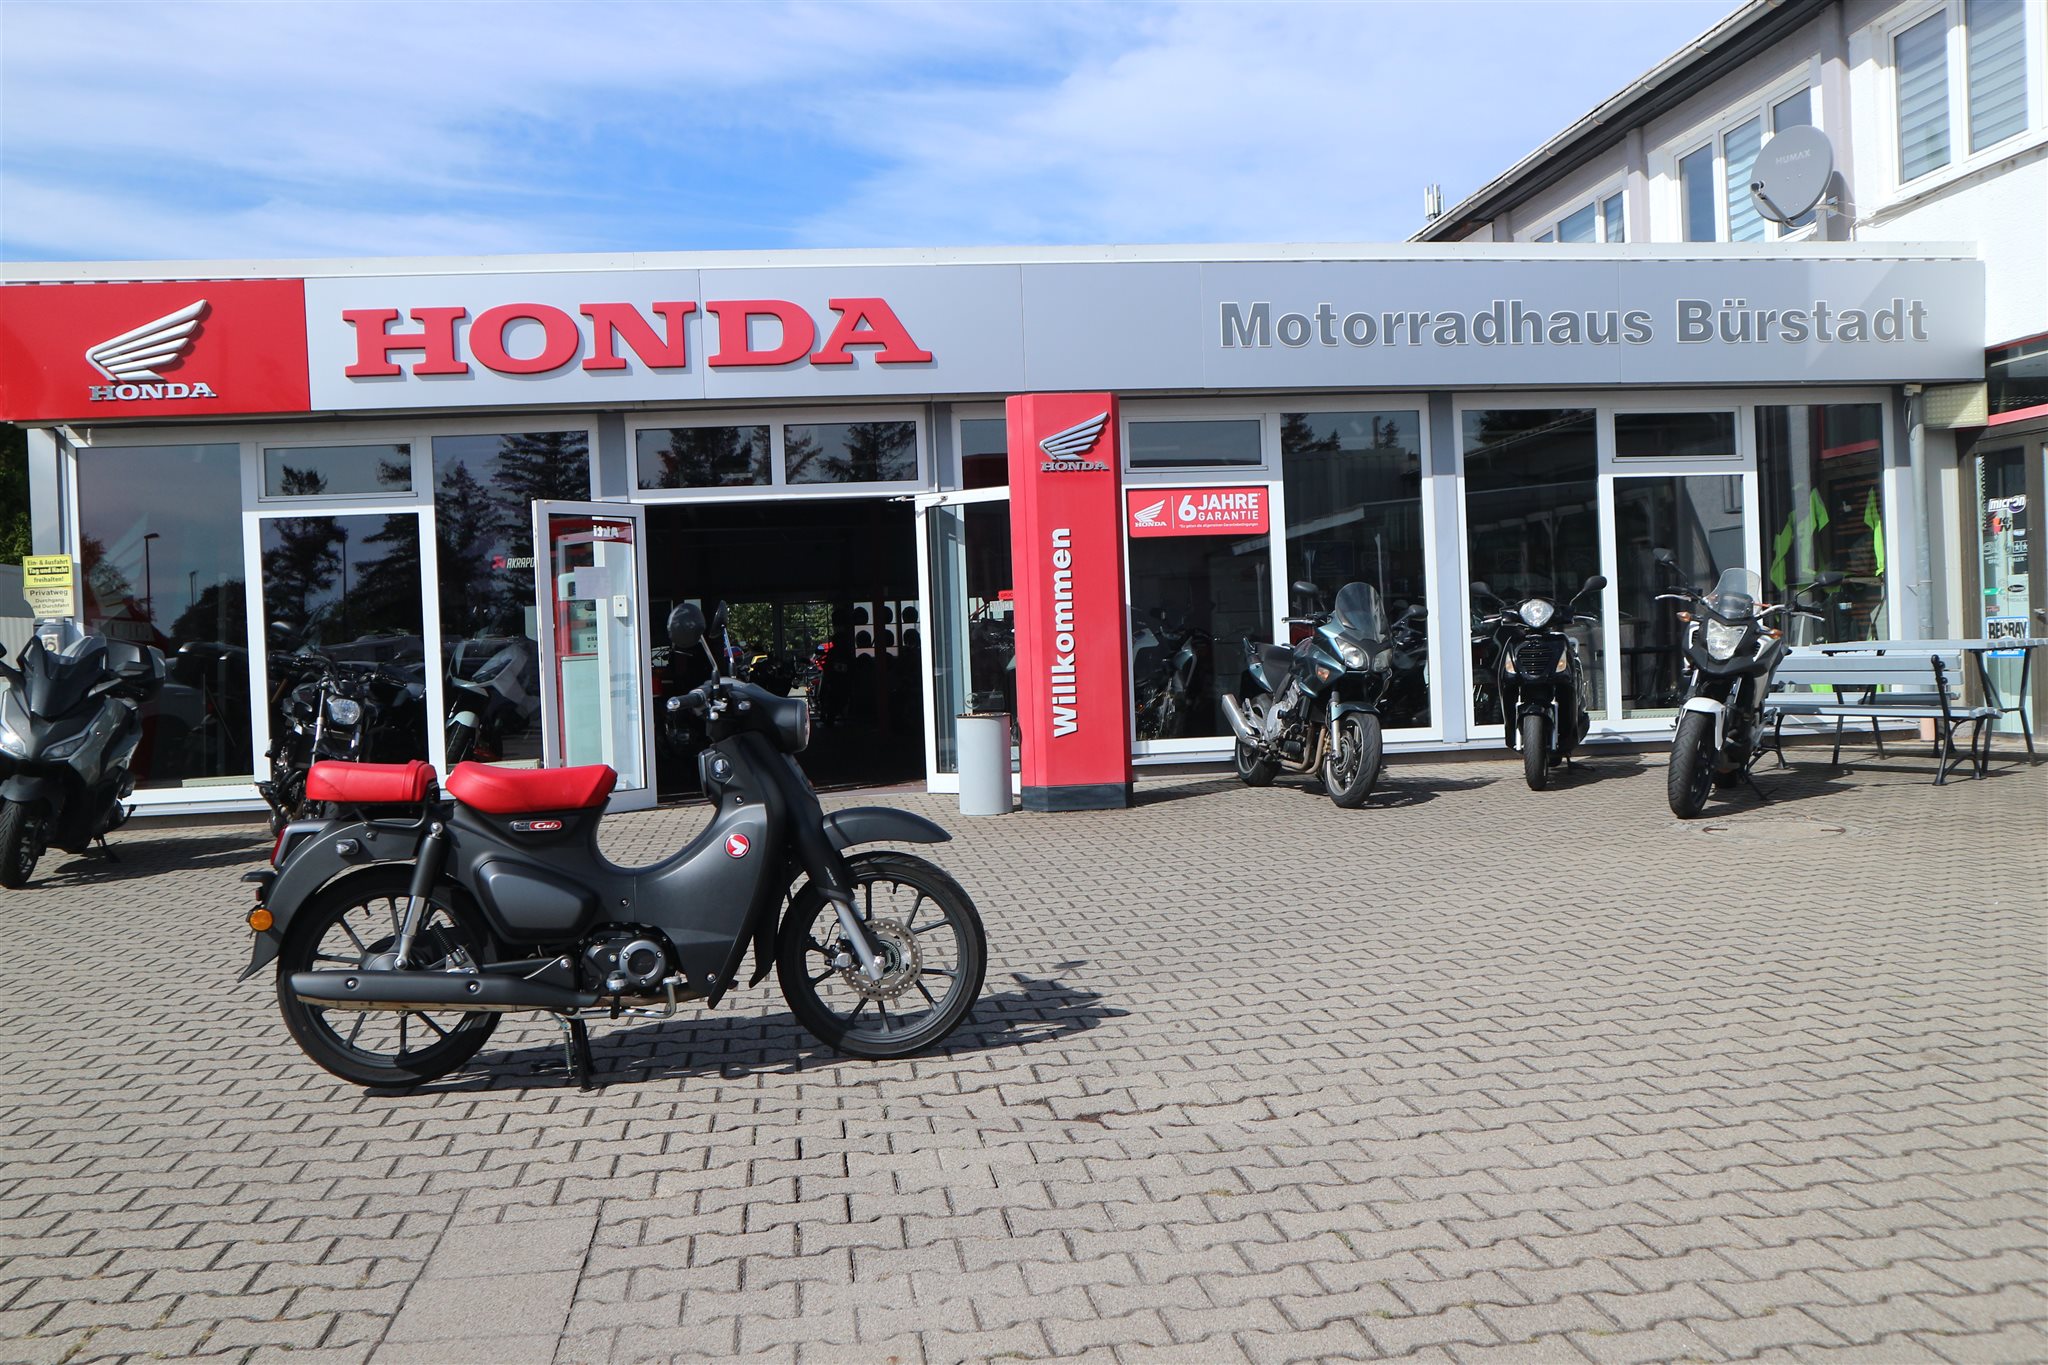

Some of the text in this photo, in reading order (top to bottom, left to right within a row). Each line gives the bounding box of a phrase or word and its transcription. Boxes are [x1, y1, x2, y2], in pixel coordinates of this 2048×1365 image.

[1775, 149, 1811, 165] HUMAX
[1220, 297, 1929, 348] Motorradhaus Bürstadt
[342, 297, 934, 378] HONDA
[89, 382, 217, 402] HONDA
[1041, 461, 1109, 472] HONDA
[1178, 494, 1198, 522] 6
[1198, 510, 1259, 521] GARANTIE
[1134, 520, 1167, 528] HONDA
[1052, 528, 1078, 738] Willkommen
